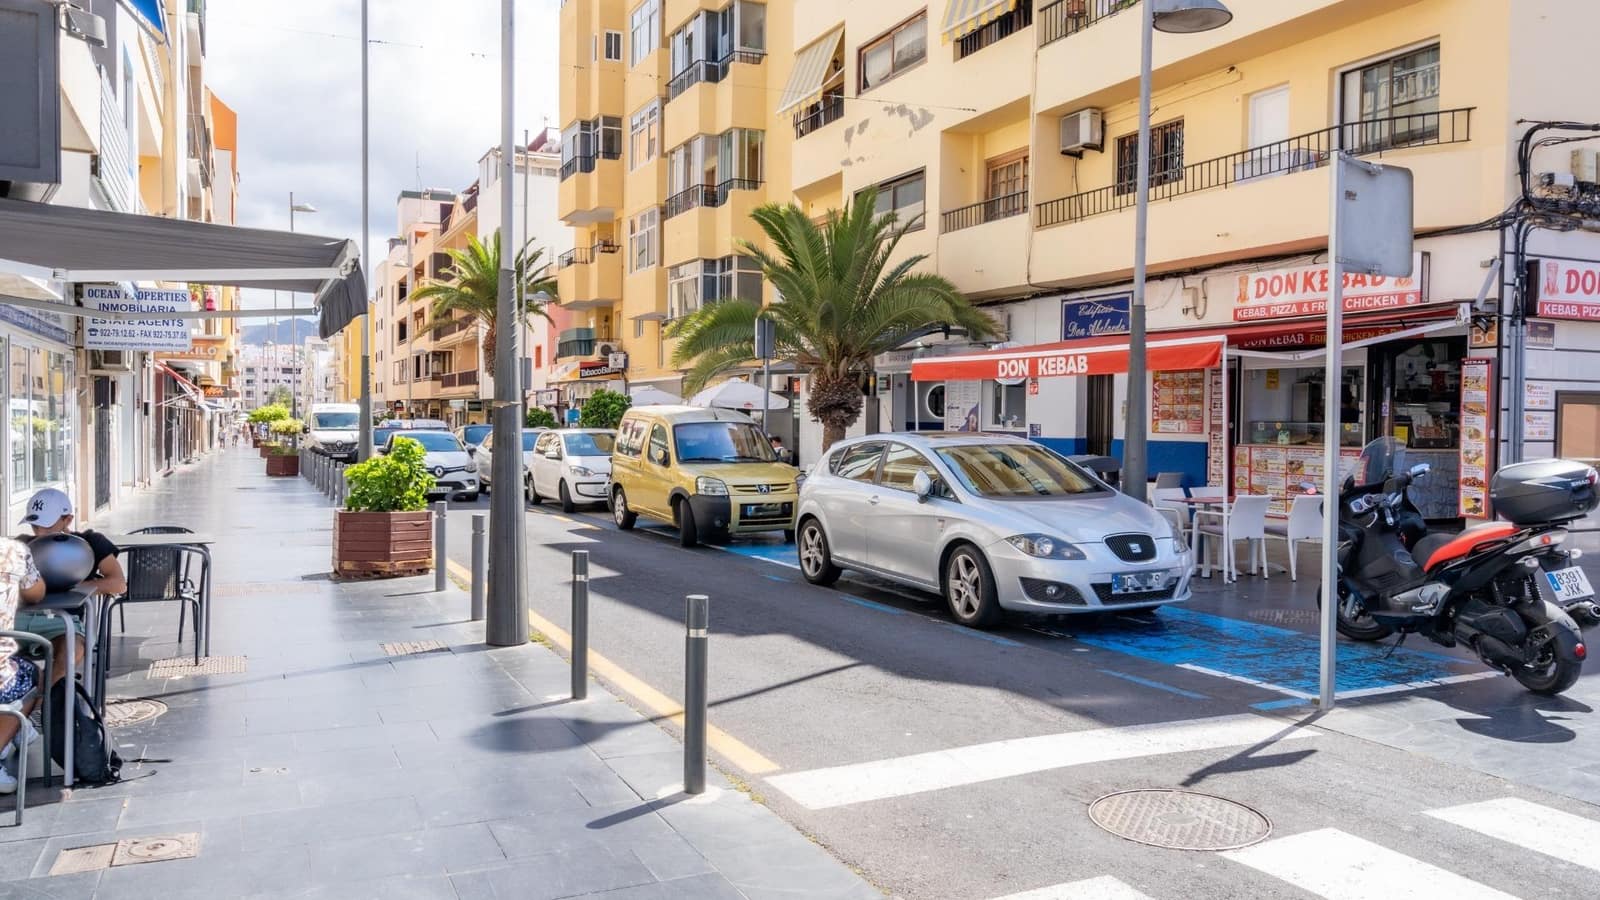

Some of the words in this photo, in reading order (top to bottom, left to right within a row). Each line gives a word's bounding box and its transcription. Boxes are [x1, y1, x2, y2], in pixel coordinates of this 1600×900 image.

[1255, 272, 1297, 299] DON
[1565, 269, 1600, 295] DO
[88, 288, 120, 299] OCEAN
[124, 289, 187, 302] POPERTIES
[98, 303, 176, 313] INMOBILIARIA
[1270, 304, 1297, 316] PIZZA
[1302, 302, 1309, 313] &
[1311, 301, 1328, 312] FRI
[1345, 295, 1399, 309] CHICKEN
[1543, 303, 1580, 317] KEBAB,
[1582, 306, 1600, 317] PIZZ
[138, 318, 184, 328] AGENTS
[1067, 321, 1085, 338] Don
[140, 331, 153, 339] FAX
[1269, 334, 1305, 345] KEBAB
[998, 359, 1029, 377] DON
[1038, 354, 1088, 375] KEBAB
[1556, 570, 1583, 584] 8391
[1564, 583, 1585, 597] JXK
